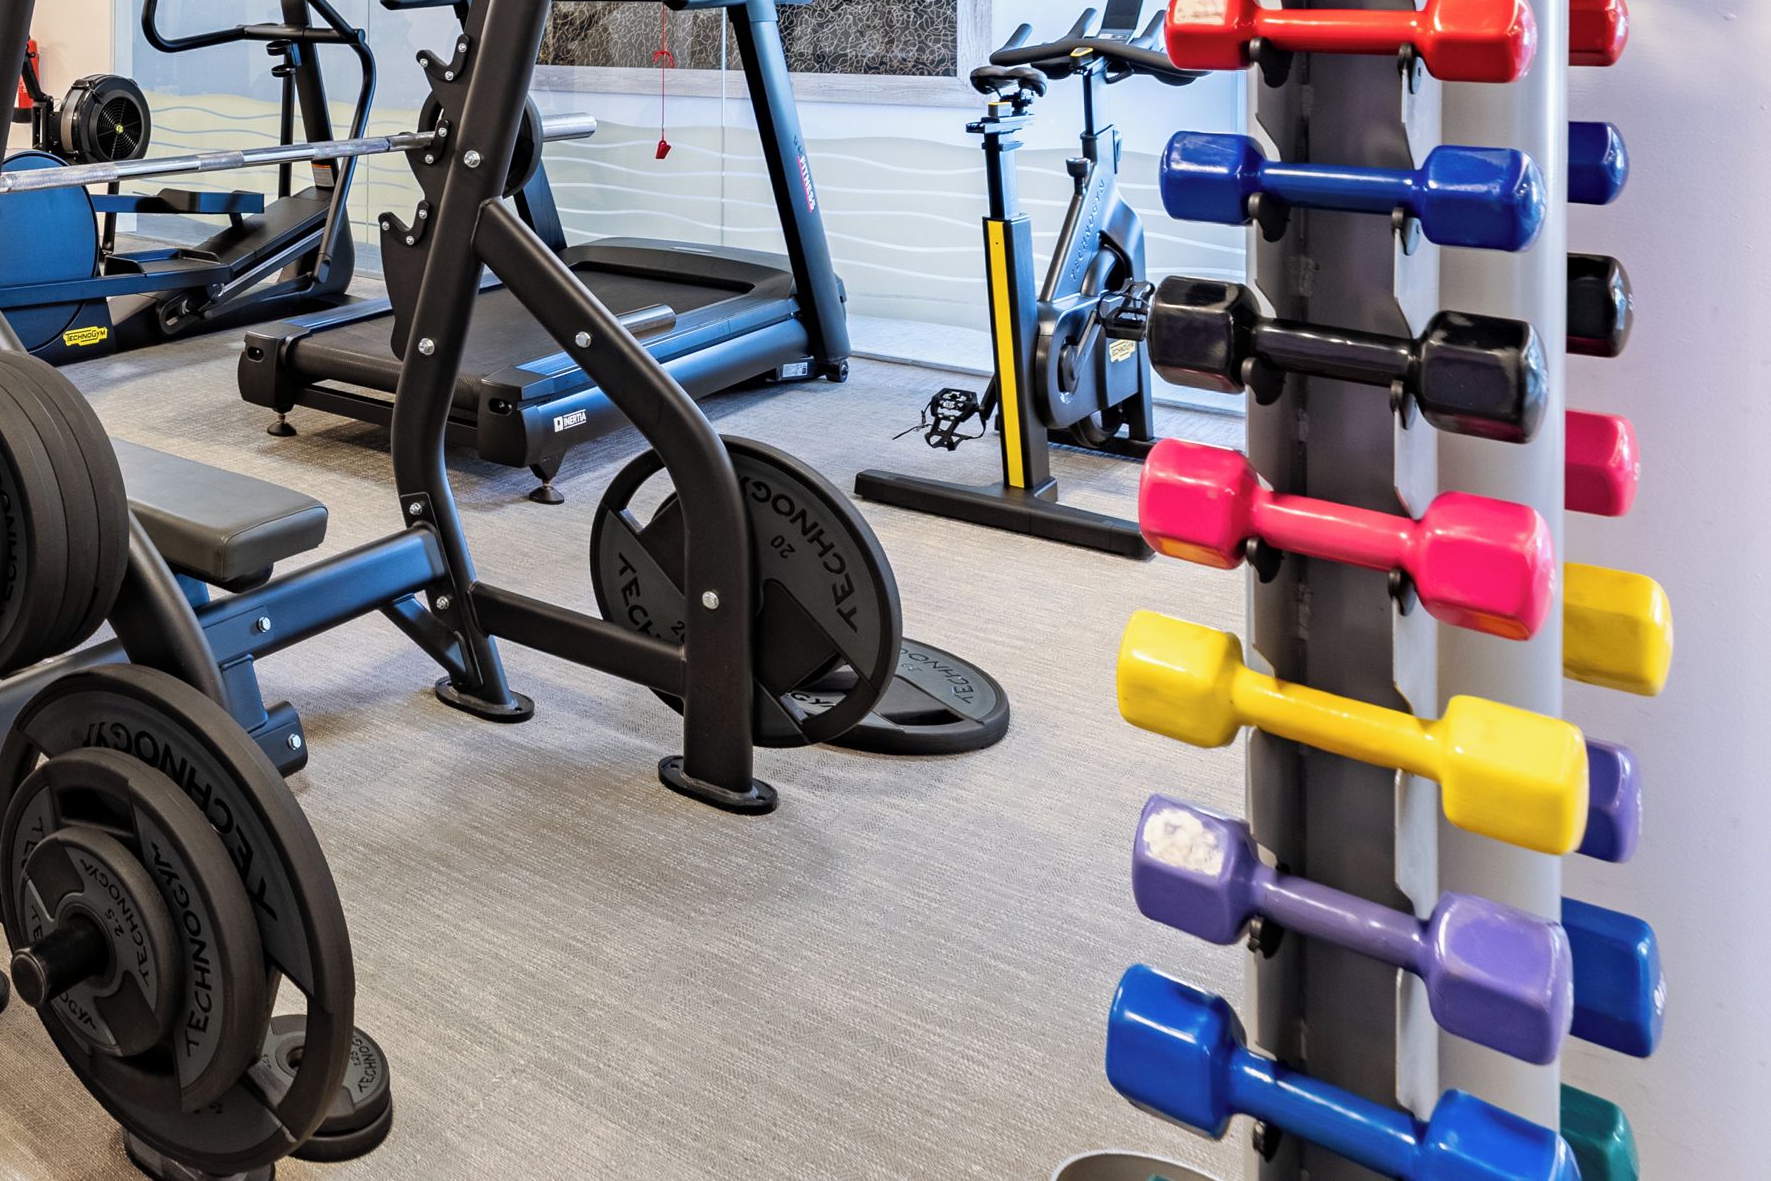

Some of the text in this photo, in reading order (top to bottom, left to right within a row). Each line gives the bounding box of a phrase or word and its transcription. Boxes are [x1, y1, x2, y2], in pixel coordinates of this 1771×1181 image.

[799, 155, 816, 212] FITNESS
[563, 411, 587, 427] INERTIA
[770, 535, 796, 559] 20
